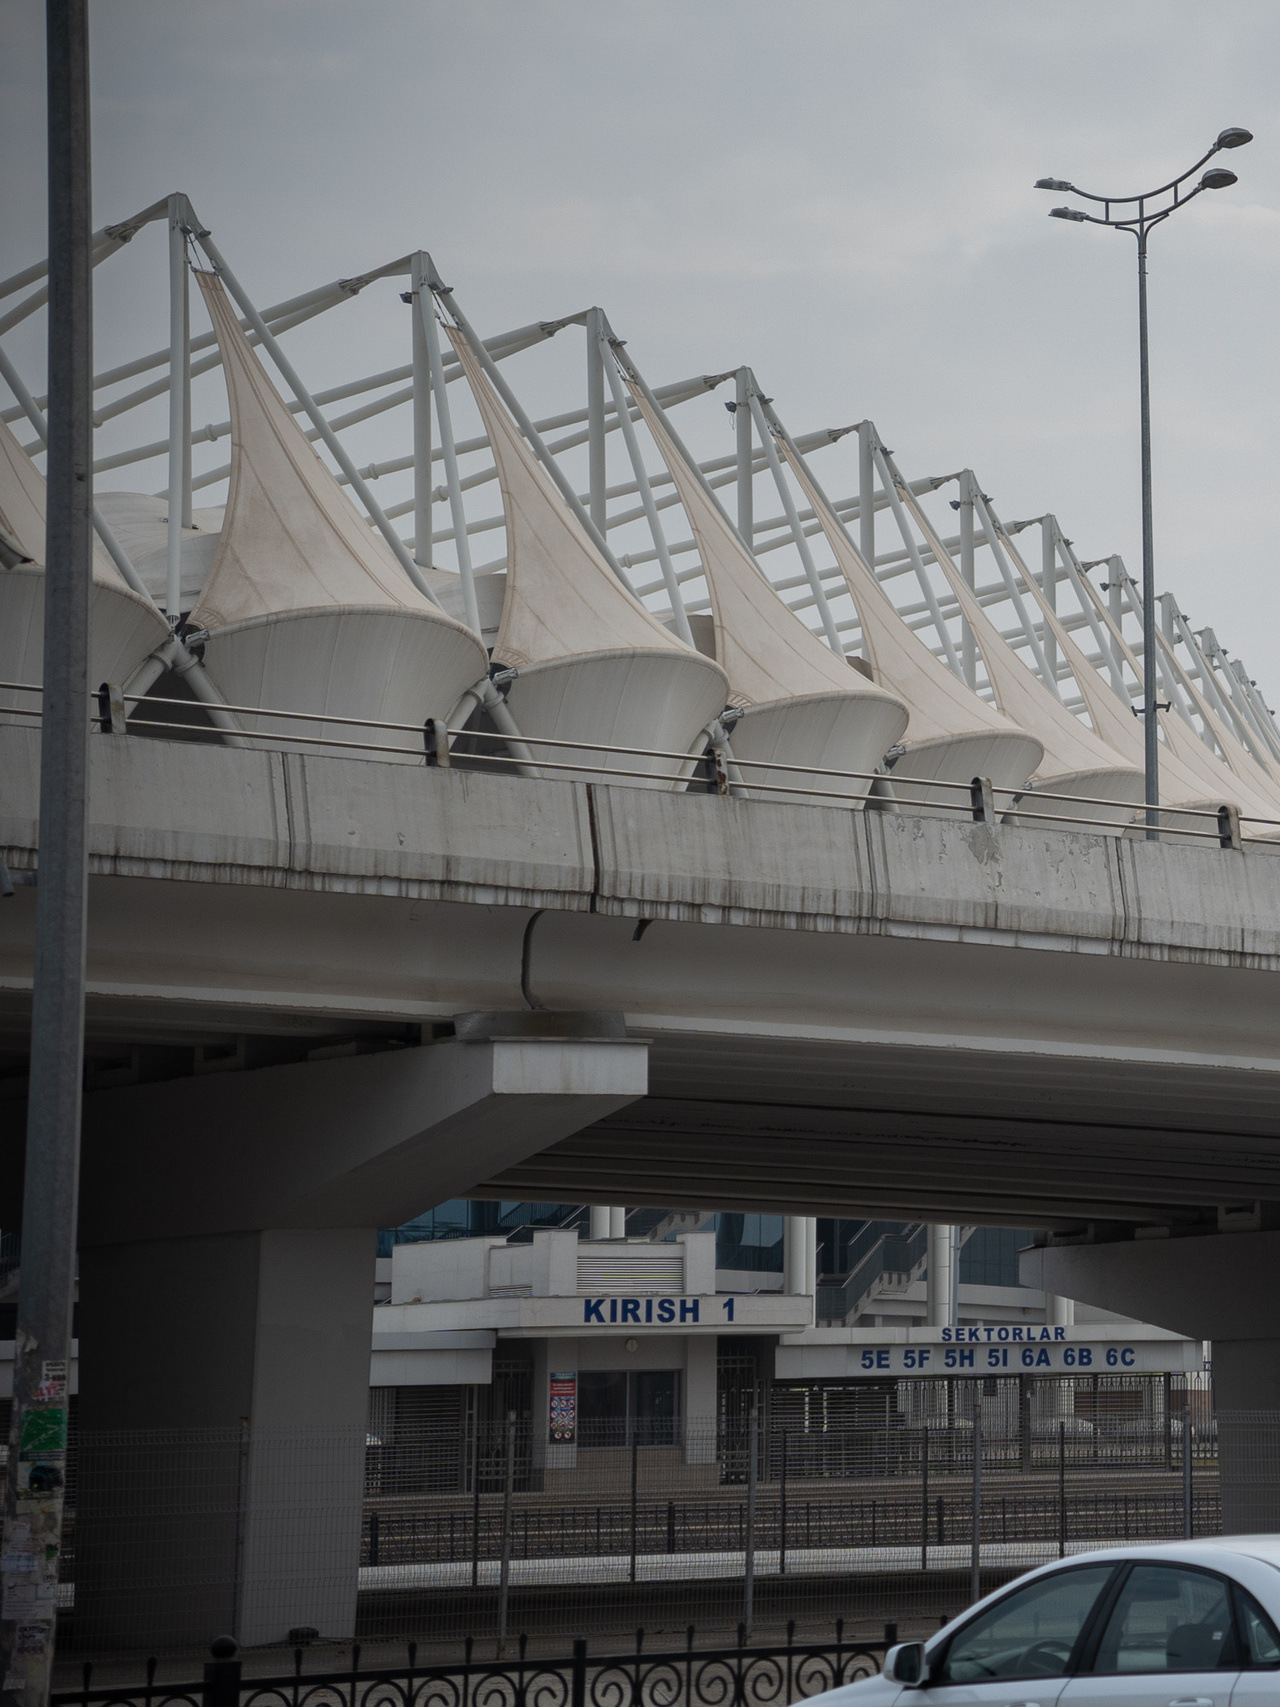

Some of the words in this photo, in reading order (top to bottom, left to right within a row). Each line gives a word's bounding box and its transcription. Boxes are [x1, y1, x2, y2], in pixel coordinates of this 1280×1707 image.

[584, 1298, 700, 1323] KIRISH
[722, 1297, 735, 1322] 1
[941, 1326, 1066, 1342] SEKTORLAR
[860, 1350, 891, 1370] 5E
[903, 1349, 931, 1369] 5F
[944, 1348, 975, 1368] 5H
[1021, 1347, 1052, 1367] 6A
[1062, 1347, 1093, 1367] 6B
[1105, 1347, 1136, 1367] 6C
